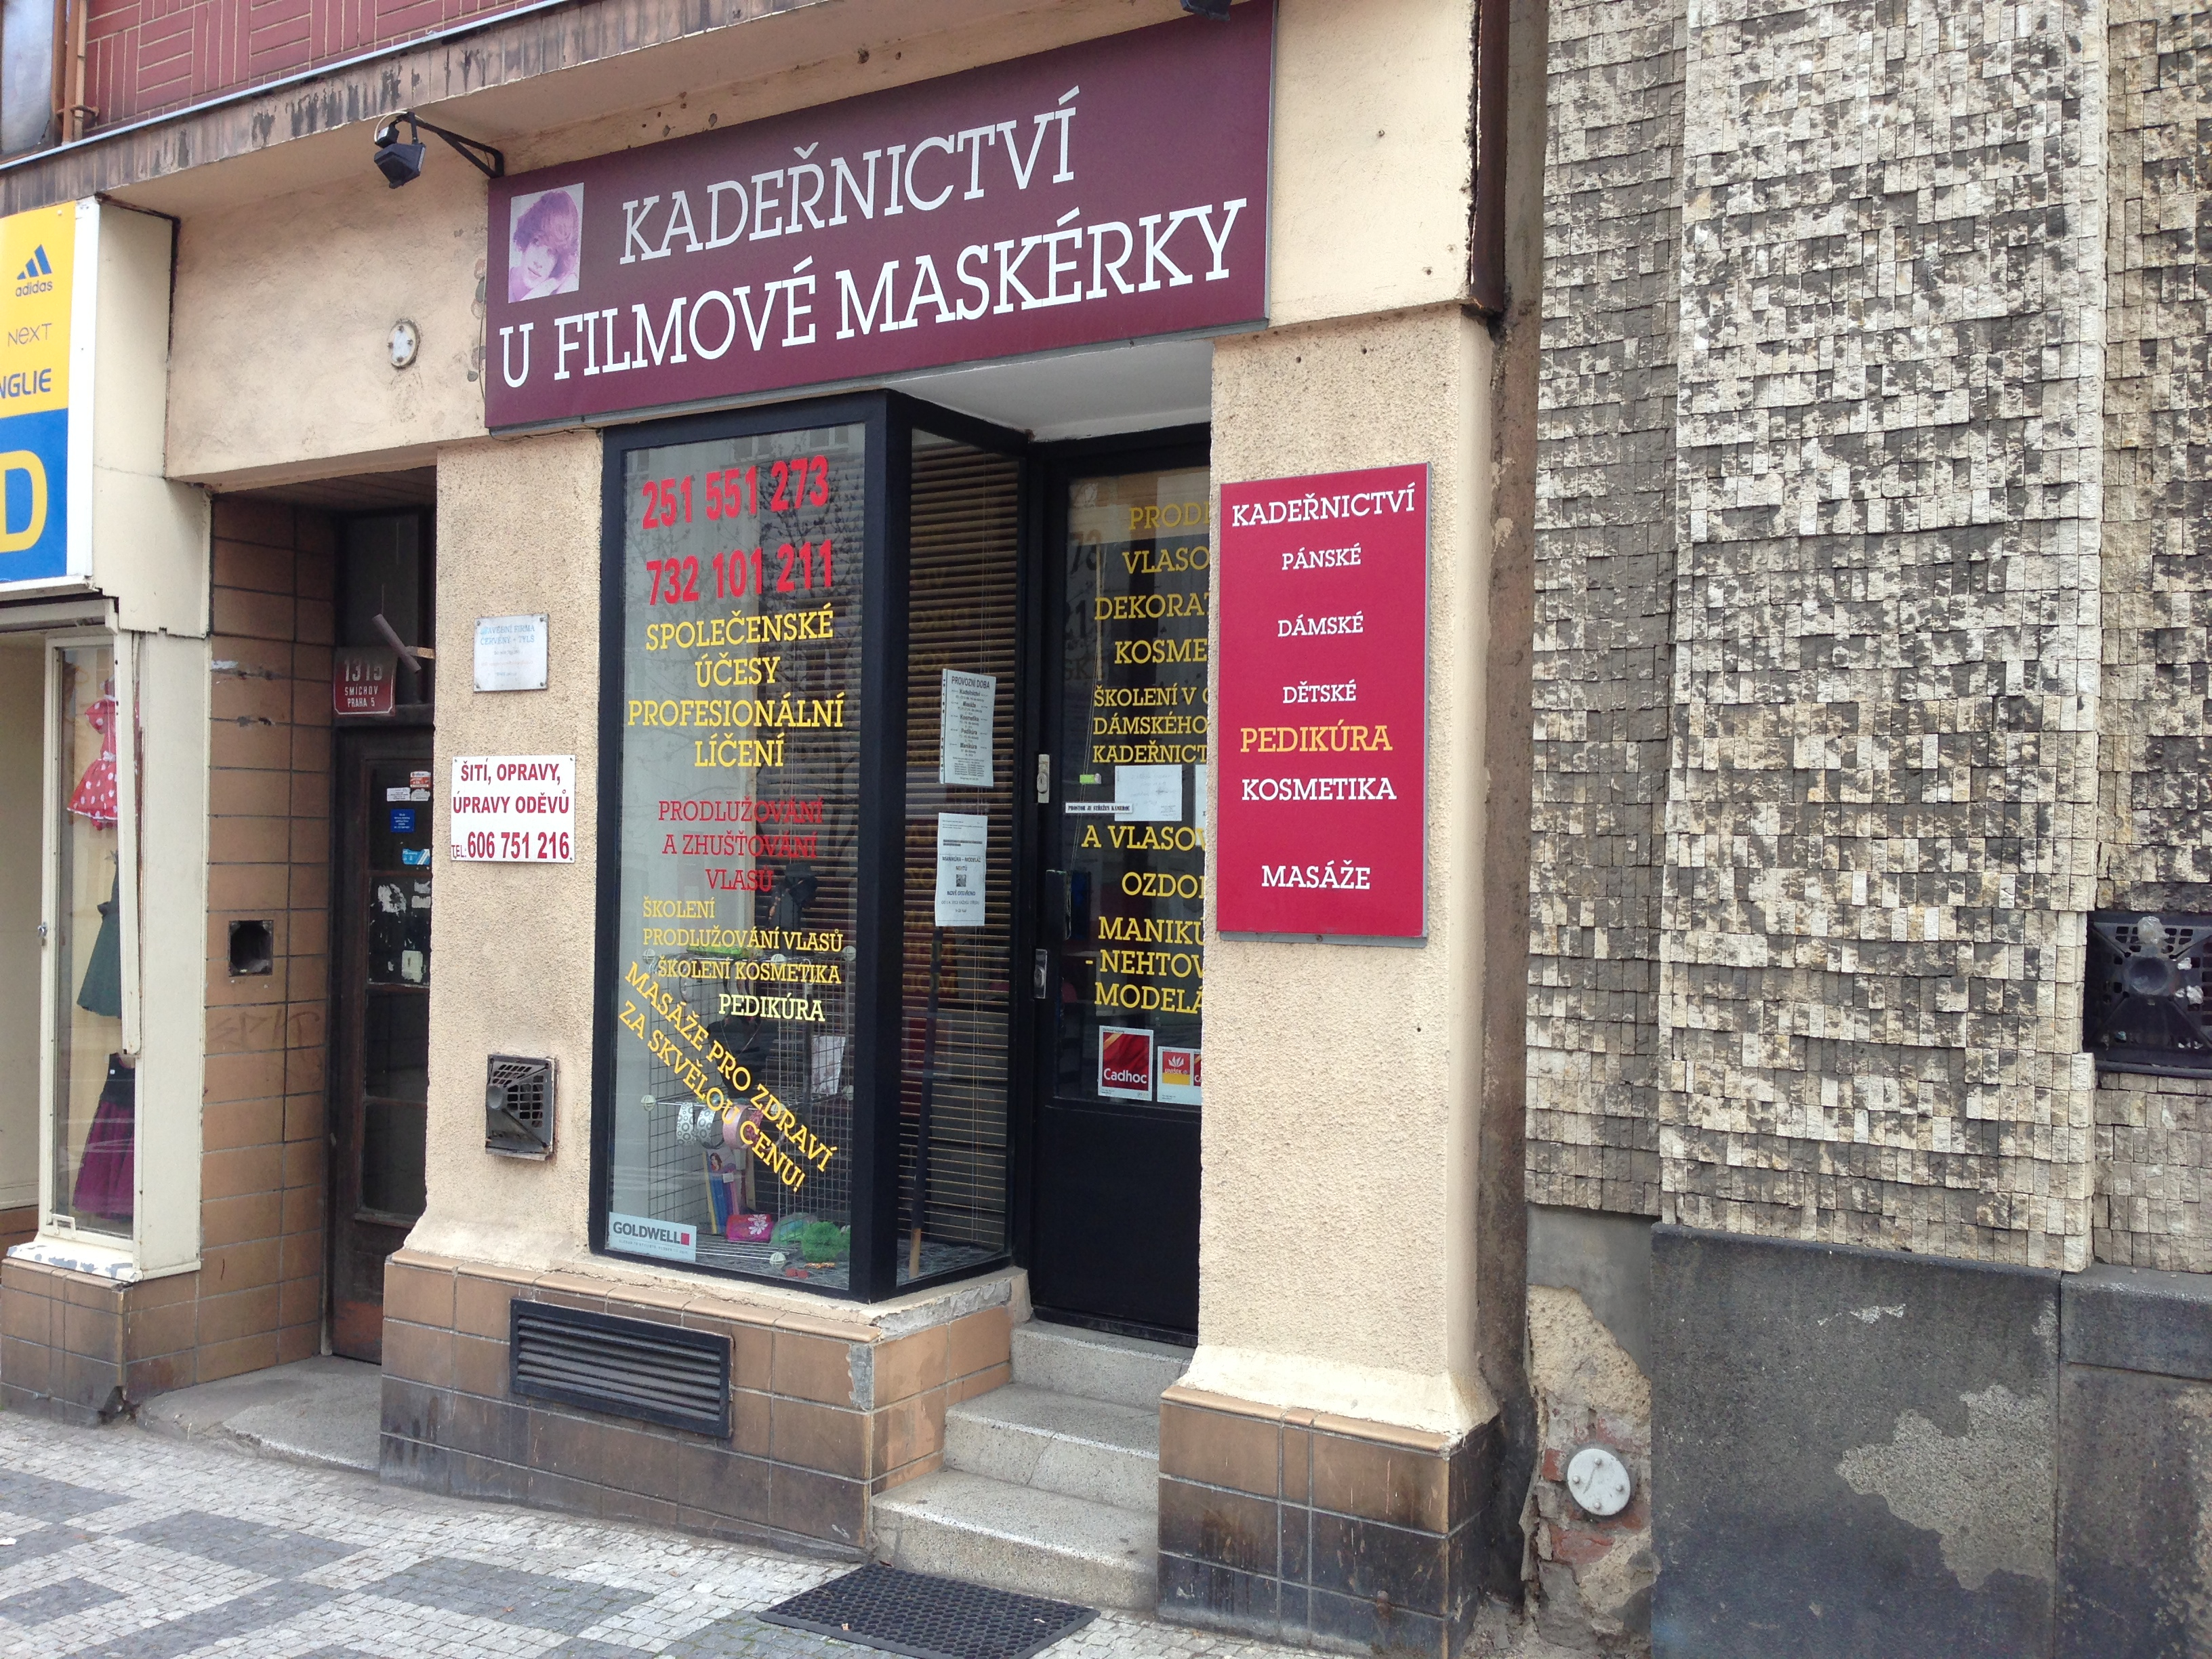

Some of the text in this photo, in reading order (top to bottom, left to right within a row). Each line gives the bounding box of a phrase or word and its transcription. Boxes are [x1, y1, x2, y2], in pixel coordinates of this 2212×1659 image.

[619, 85, 1080, 264] KADEŘNICTVÍ
[16, 280, 53, 297] adidas
[499, 198, 1247, 388] U FILMOVÉ MASKÉRKY
[642, 455, 830, 530] 251 551 273
[1232, 483, 1416, 527] KADEŘNICTVÍ
[1282, 542, 1362, 571] PÁNSKÉ
[647, 539, 833, 606] 732 101 211
[1094, 592, 1209, 620] DEKORA
[646, 602, 834, 651] SPOLEČENSKÉ
[1278, 611, 1364, 637] DÁMSKÉ
[695, 653, 781, 688] ÚČESY
[951, 676, 990, 689] PROVOZNÍ DOBA
[344, 684, 378, 696] SMÍCHOV
[347, 697, 375, 708] PRAHA 5
[1094, 682, 1178, 707] ŠKOLENÍ
[1181, 687, 1197, 705] V
[1283, 679, 1357, 704] DĚTSKÉ
[628, 692, 845, 728] PROFESIONÁLNÍ
[1093, 712, 1208, 735] DÁMSKÉHO
[694, 732, 785, 768] LÍČENÍ
[1241, 720, 1393, 754] PEDIKÚRA
[461, 758, 560, 785] ŠITÍ, OPRAVY,
[453, 790, 569, 814] ÚPRAVY ODĚVŮ
[1242, 777, 1397, 801] KOSMETIKA
[658, 796, 824, 824] PRODLUŽOVÁNÍ
[468, 832, 495, 859] 606
[501, 832, 529, 859] 751
[537, 832, 569, 859] 216
[661, 830, 818, 859] A ZHUŠŤOVÁNÍ
[1081, 825, 1102, 847] A
[705, 865, 774, 892] VLASŮ
[1261, 859, 1371, 890] MASÁŽE
[642, 895, 716, 918] ŠKOLENÍ
[642, 924, 843, 953] PRODLUŽOVÁNÍ VLASŮ
[657, 954, 842, 984] ŠKOLENÍ KOSMETIKA
[718, 993, 825, 1022] PEDIKÚRA
[624, 962, 838, 1173] MASÁŽE PRO ZDRAVÍ
[1103, 1068, 1147, 1084] Cadhoc
[619, 1000, 806, 1193] ZA SKVĚLOU CENU!
[613, 1222, 680, 1244] GOLDWELL
